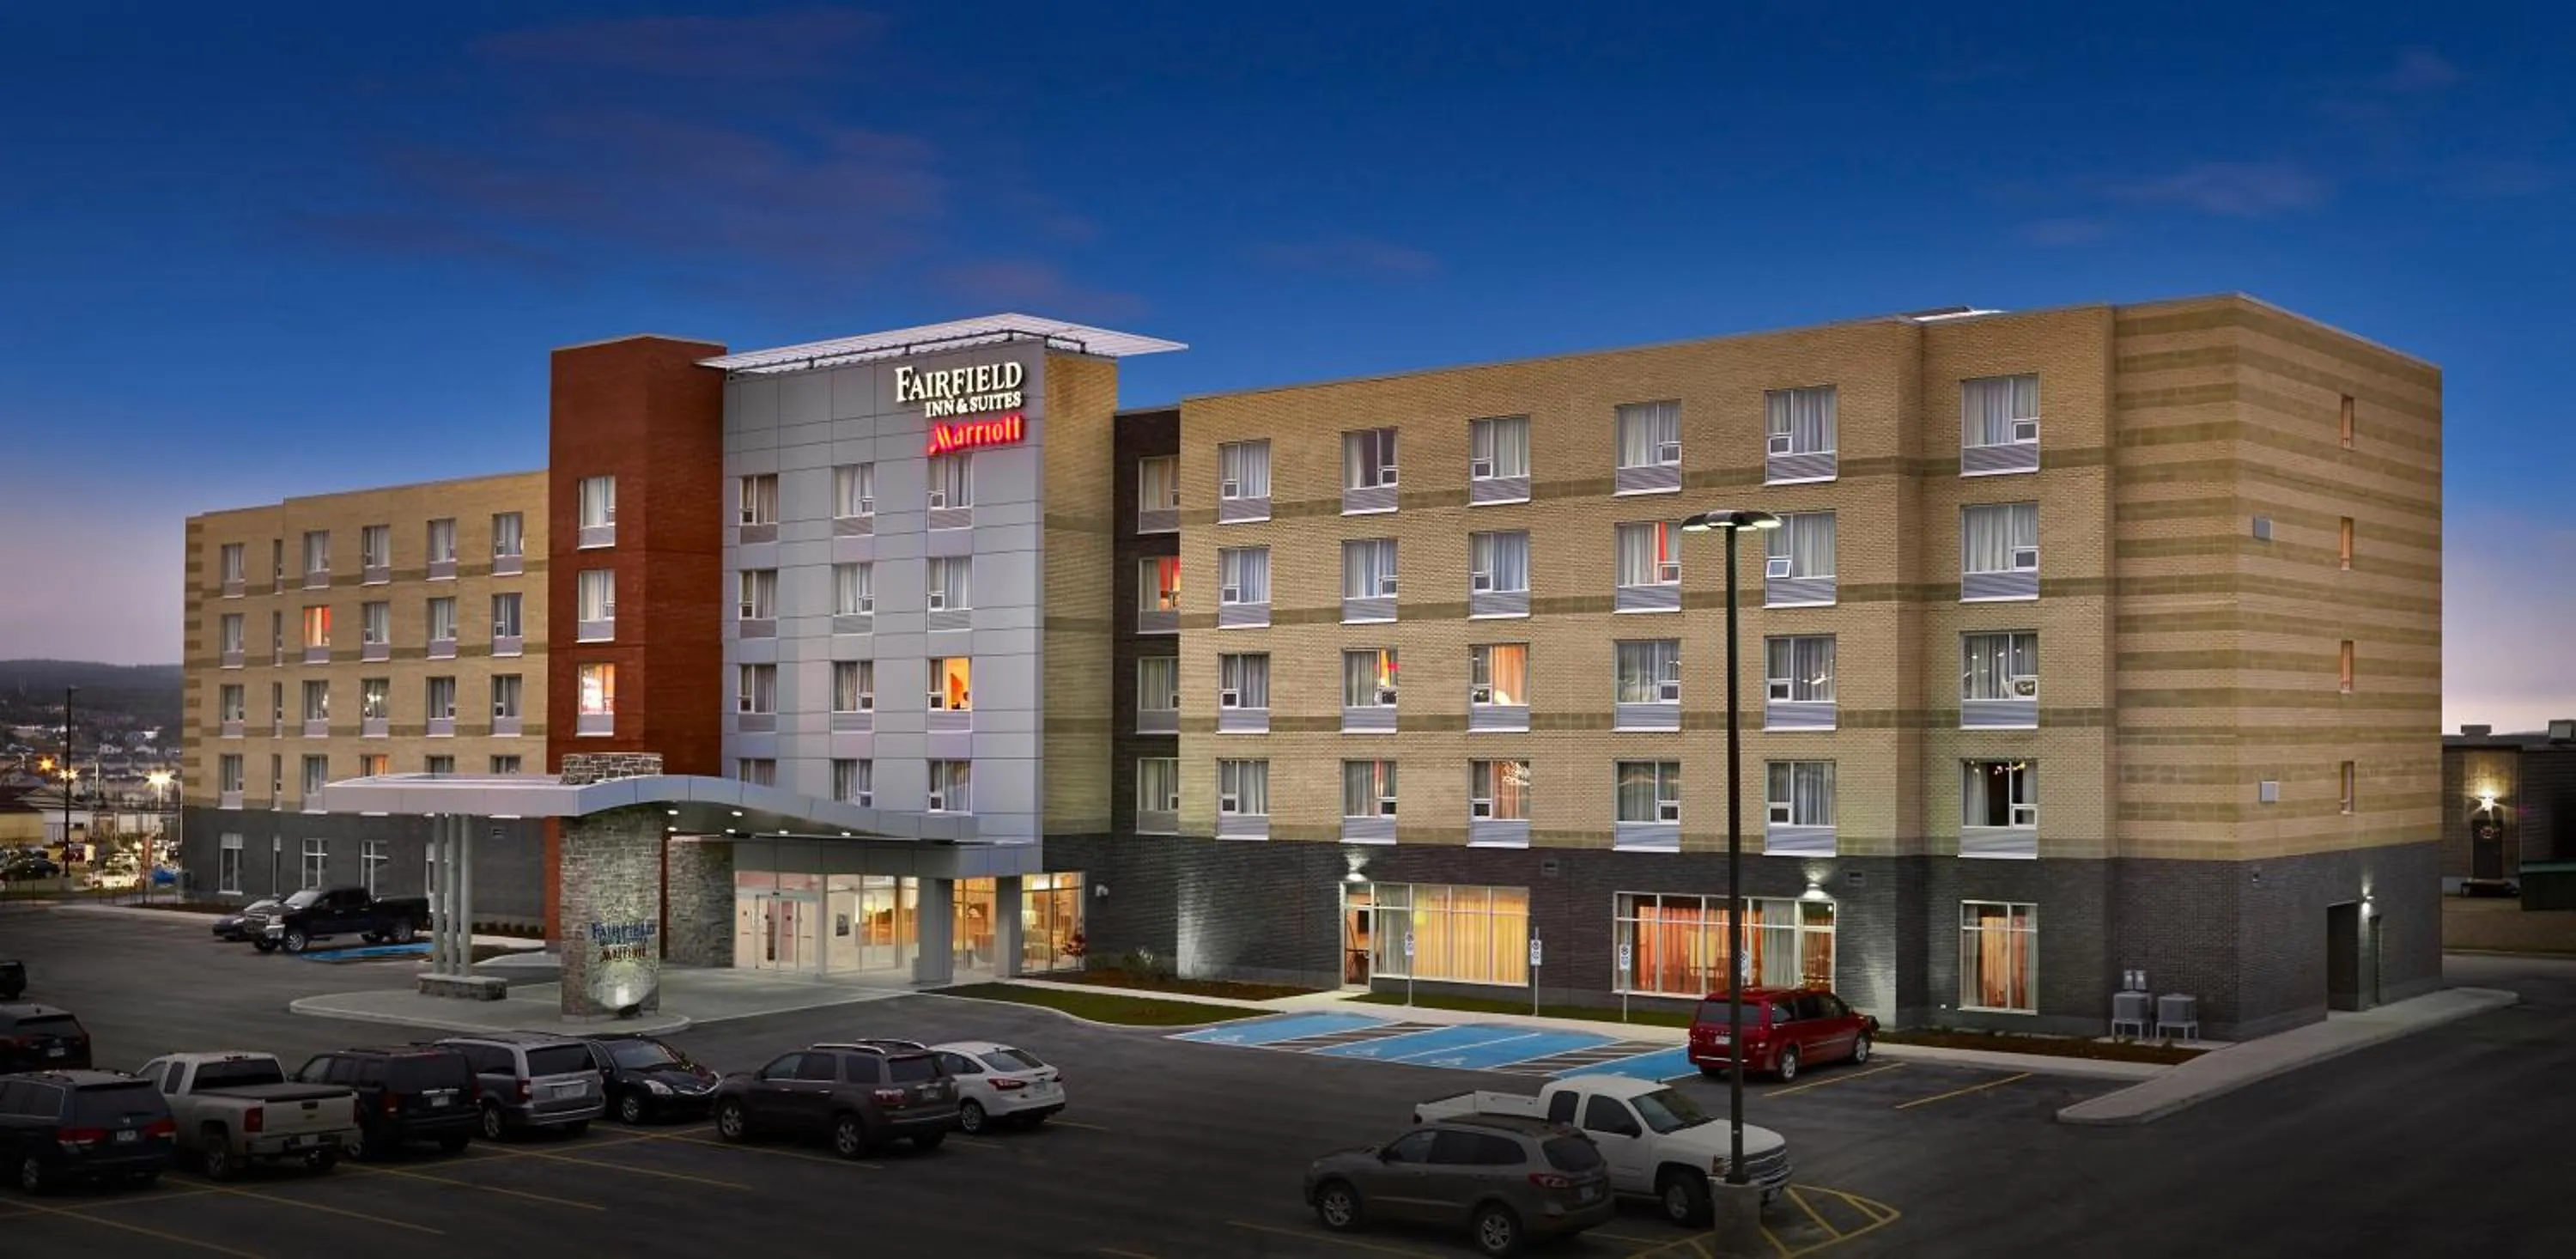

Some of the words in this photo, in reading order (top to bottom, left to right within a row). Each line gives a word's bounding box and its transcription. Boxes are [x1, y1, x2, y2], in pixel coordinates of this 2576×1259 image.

[895, 362, 1023, 403] FAIRFIELD
[925, 399, 955, 418] INN
[956, 398, 969, 415] &
[969, 392, 1022, 412] SUITES
[928, 414, 1023, 455] Marriott
